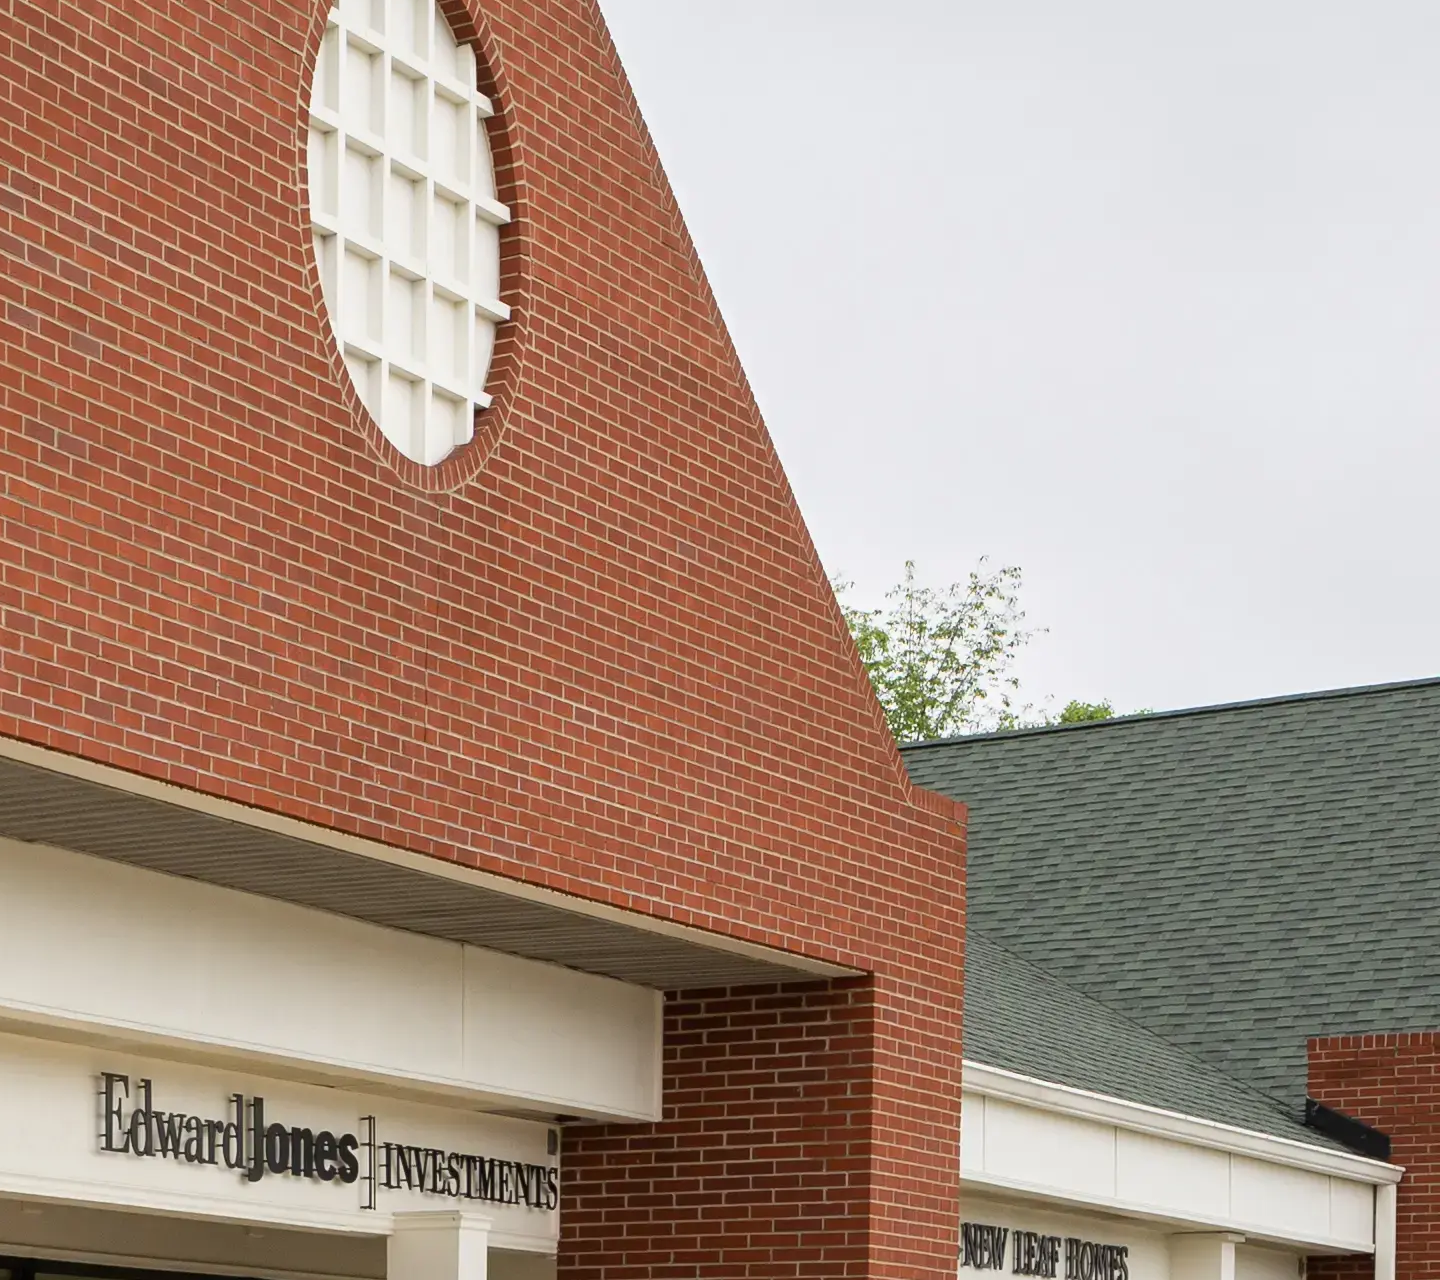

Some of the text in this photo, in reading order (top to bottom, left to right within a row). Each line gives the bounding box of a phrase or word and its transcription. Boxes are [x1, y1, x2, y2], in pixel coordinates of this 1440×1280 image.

[100, 1071, 559, 1212] Edward Jones INVESTMENTS
[960, 1222, 1010, 1271] NEW
[1012, 1230, 1062, 1279] LEAF
